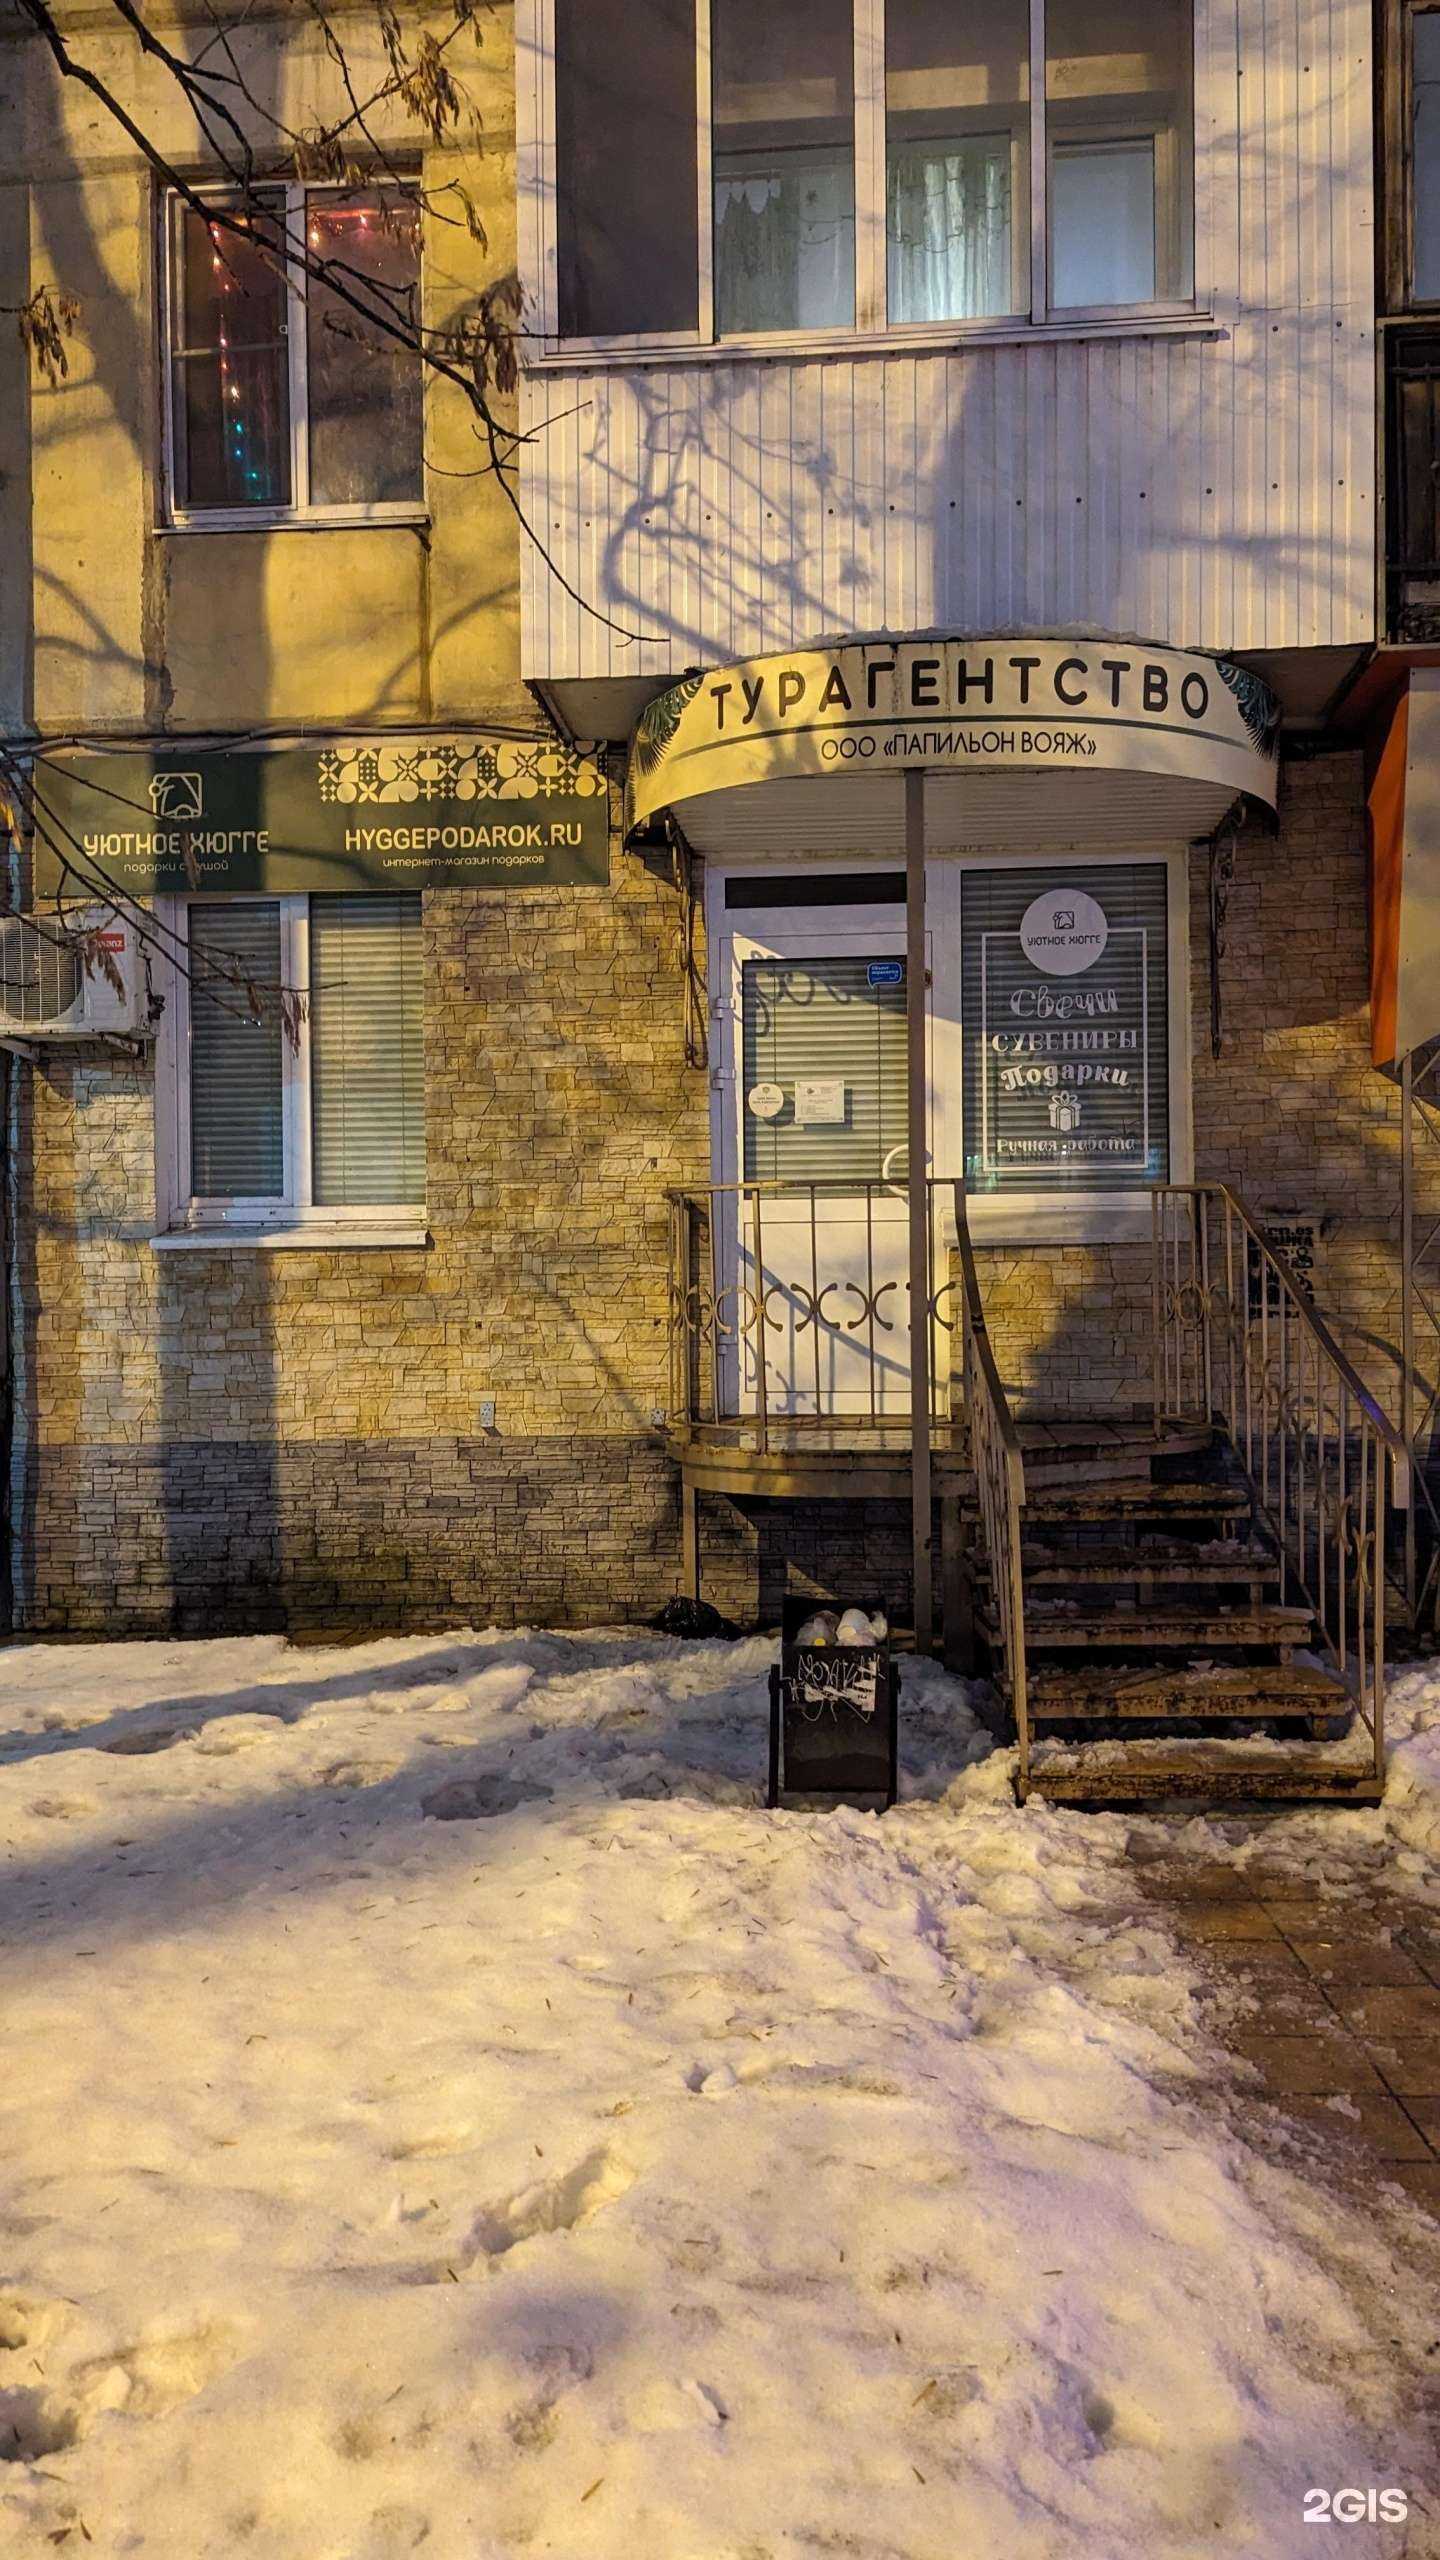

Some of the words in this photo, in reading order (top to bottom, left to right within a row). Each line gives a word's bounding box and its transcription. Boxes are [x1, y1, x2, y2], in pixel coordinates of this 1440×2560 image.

[710, 657, 1209, 730] ТУРАГЕНТСТВО
[821, 736, 876, 760] ООО
[883, 730, 1015, 757] «ПАПИЛЬОН
[1021, 731, 1096, 756] ВОЯЖ»
[83, 832, 181, 857] УЮТНОЕ
[189, 830, 270, 854] ХЮГГЕ
[345, 823, 583, 851] HYGGEPODAROK.RU
[123, 863, 176, 874] подарки
[382, 856, 490, 869] интернет-магазин
[492, 855, 545, 867] подарков
[1027, 936, 1066, 946] УЮТНОЕ
[1069, 935, 1101, 944] ХЮГГЕ
[1010, 985, 1119, 1019] Свечи
[991, 1030, 1137, 1053] СУВЕНИРЫ
[1000, 1063, 1129, 1091] Подарки
[997, 1139, 1057, 1154] Ручная
